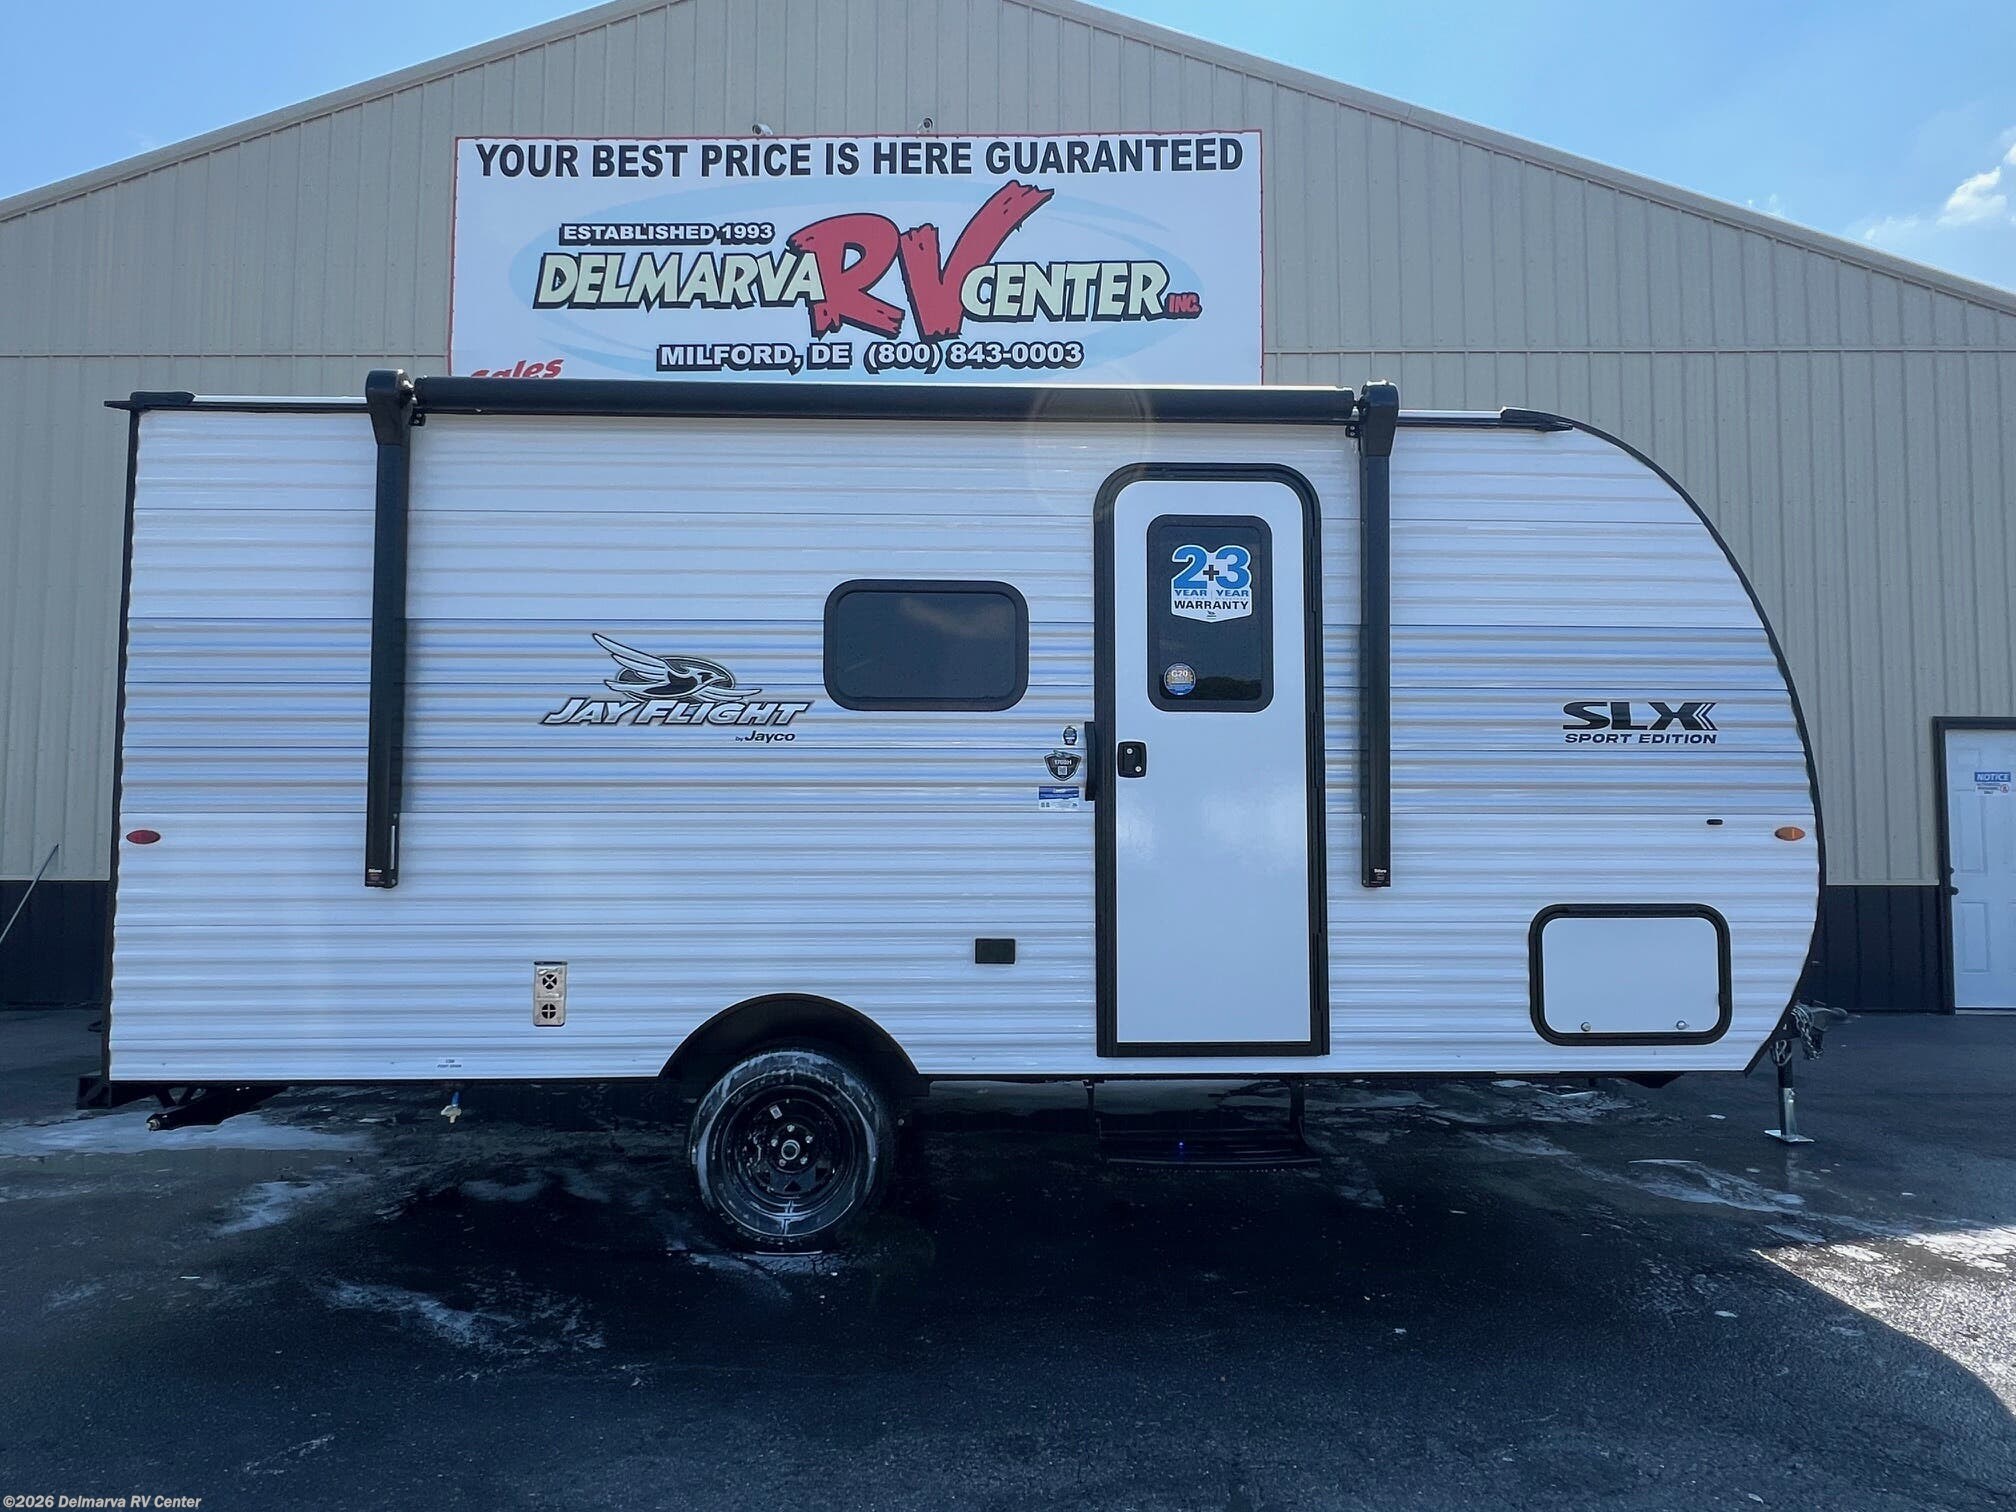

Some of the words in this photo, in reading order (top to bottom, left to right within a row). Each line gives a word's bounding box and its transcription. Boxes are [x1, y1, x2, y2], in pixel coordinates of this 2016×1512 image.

[476, 143, 580, 178] YOUR
[592, 143, 689, 178] BEST
[701, 142, 812, 177] PRICE
[825, 142, 859, 176] IS
[873, 141, 972, 176] HERE
[985, 137, 1244, 175] GUARANTEED
[561, 223, 715, 244] ESTABLISHED
[721, 223, 776, 243] 1993
[533, 252, 826, 311] DELMARVA
[787, 180, 1055, 338] RV
[961, 261, 1170, 322] CENTER
[1166, 293, 1202, 318] INC.
[656, 344, 803, 374] MILFORD,
[807, 342, 852, 371] DE
[864, 342, 942, 373] (800)
[947, 342, 1084, 369] 843-0003
[1174, 589, 1207, 597] YEAR
[1216, 589, 1249, 597] YEAR
[1174, 600, 1249, 610] WARRANTY
[540, 696, 637, 725] JAY
[631, 699, 815, 727] FLIGHT
[1563, 701, 1718, 731] SLX
[744, 730, 796, 744] Jayco
[1565, 733, 1633, 744] SPORT
[1638, 734, 1717, 744] EDITION
[1976, 773, 2009, 781] NOTICE
